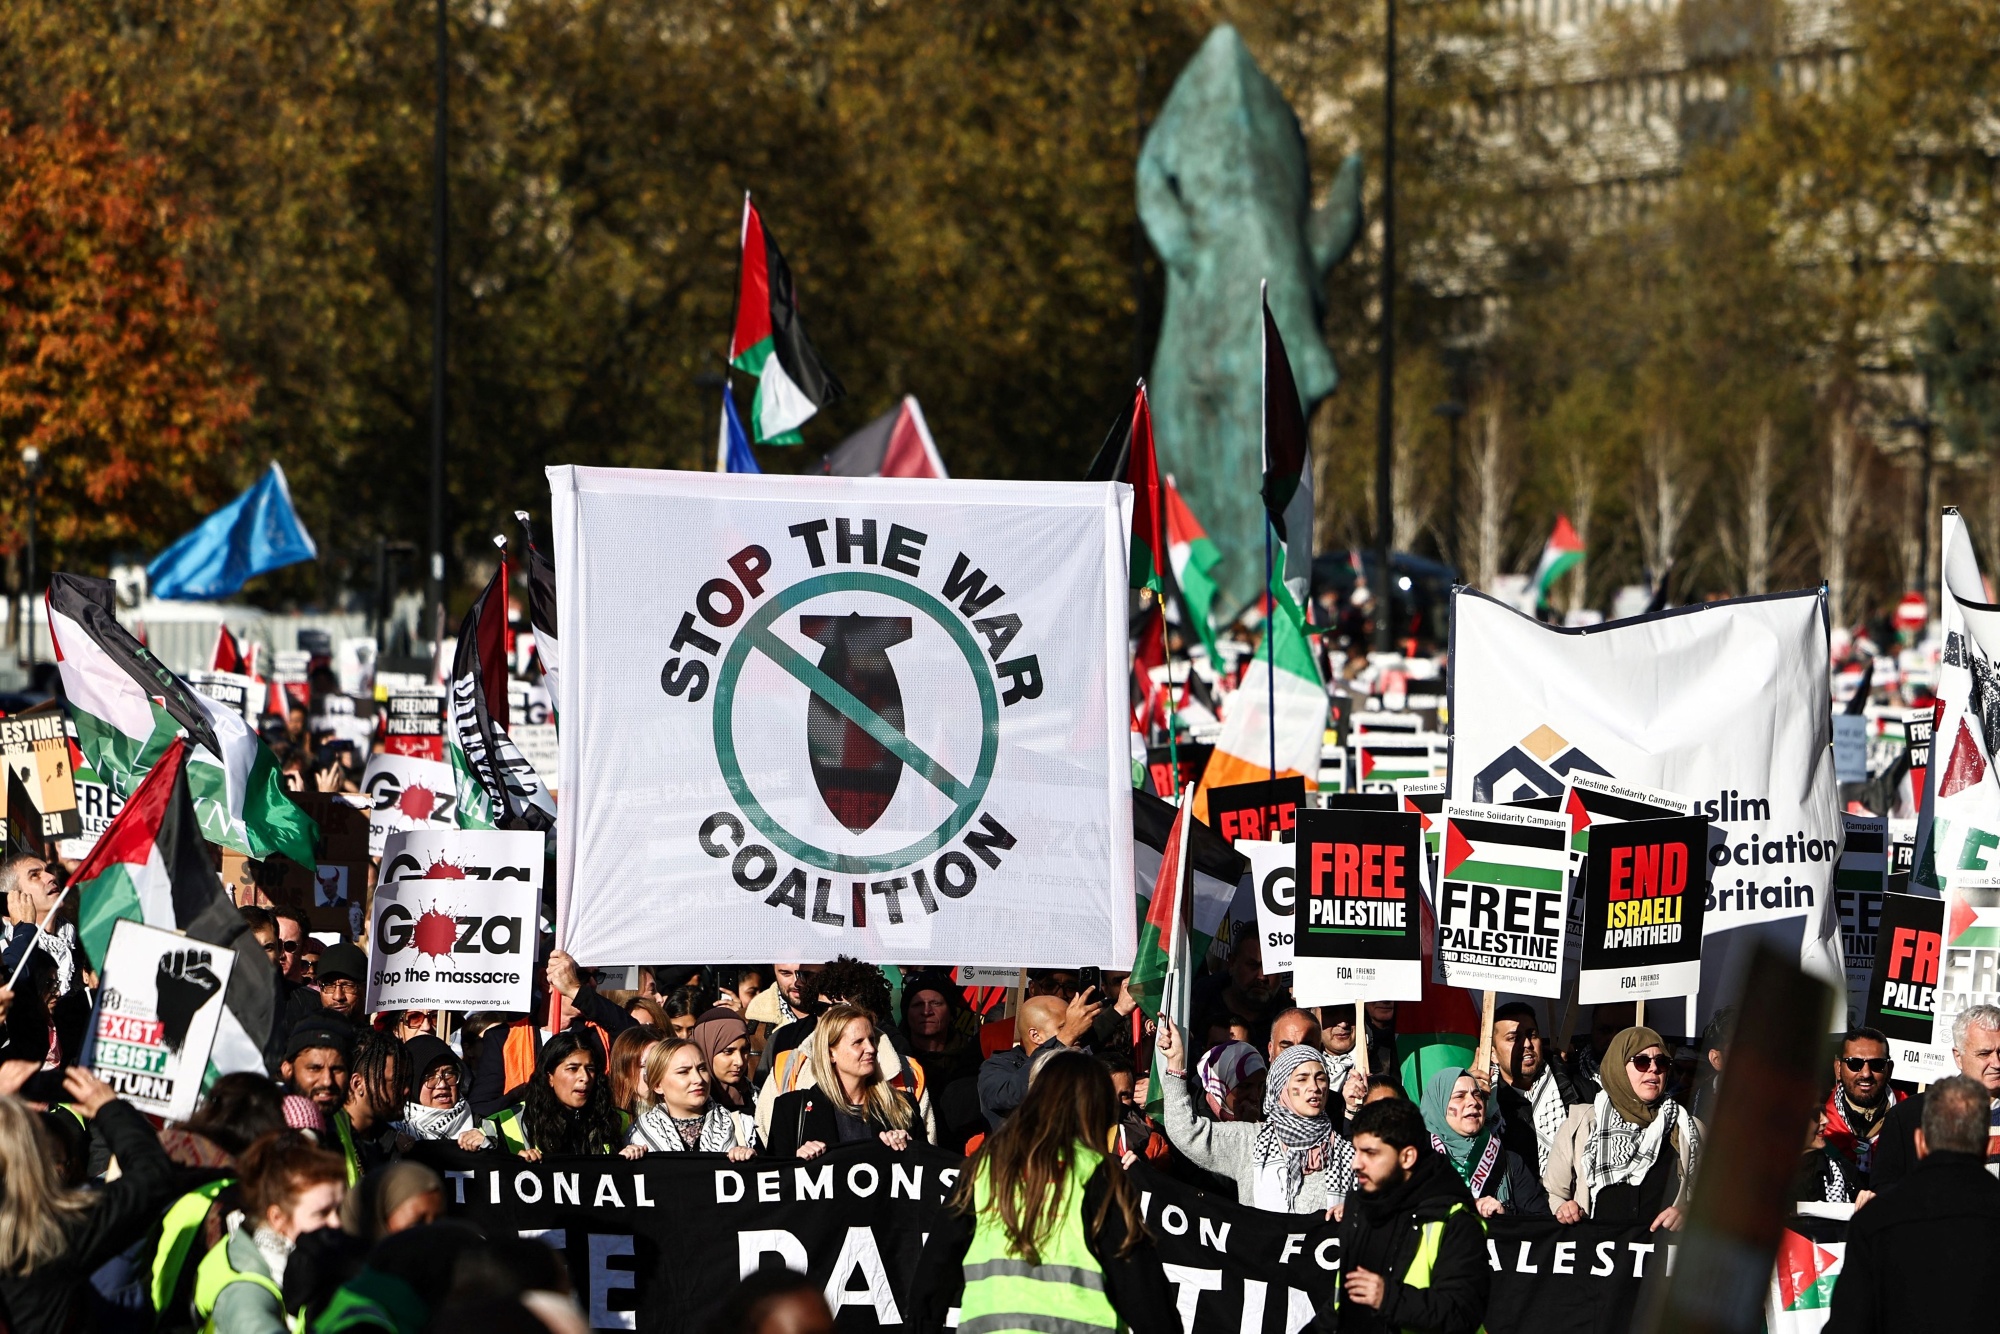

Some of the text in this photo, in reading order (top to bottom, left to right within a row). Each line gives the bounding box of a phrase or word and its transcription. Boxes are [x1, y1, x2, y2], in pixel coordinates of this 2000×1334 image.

[660, 517, 1044, 708] STOP THE WAR
[391, 698, 439, 713] FREEDOM
[0, 716, 64, 745] ESTINE
[388, 719, 440, 734] PALESTINE
[1910, 722, 1932, 741] FRE
[1403, 783, 1438, 792] Palestine
[1573, 775, 1688, 811] Palestine Solidarity Campaign
[1448, 806, 1567, 829] Palestine Solidarity Campaign
[1845, 821, 1884, 832] Campaign
[698, 811, 1017, 928] COALITION
[1311, 842, 1406, 899] FREE
[1609, 842, 1688, 901] END
[1261, 866, 1295, 917] G
[1308, 898, 1407, 928] PALESTINE
[1441, 881, 1562, 937] FREE
[1607, 896, 1683, 929] ISRAELI
[377, 903, 522, 956] Gza
[1268, 931, 1295, 948] Sto
[1438, 926, 1558, 960] PALESTINE
[1603, 924, 1682, 949] APARTHEID
[1336, 966, 1352, 979] FOA
[1460, 951, 1497, 967] ISRAELI
[1498, 957, 1556, 973] OCCUPATION
[373, 967, 521, 987] Stop the massacre
[1455, 969, 1538, 985] www.palestinecampaign.org
[1620, 976, 1637, 989] FOA
[444, 999, 511, 1007] www.stopwar.org.uk
[97, 1014, 161, 1045] EXIST.
[1903, 1049, 1920, 1063] FOA
[1470, 1135, 1501, 1191] ESTINE
[444, 1168, 655, 1208] TIONAL
